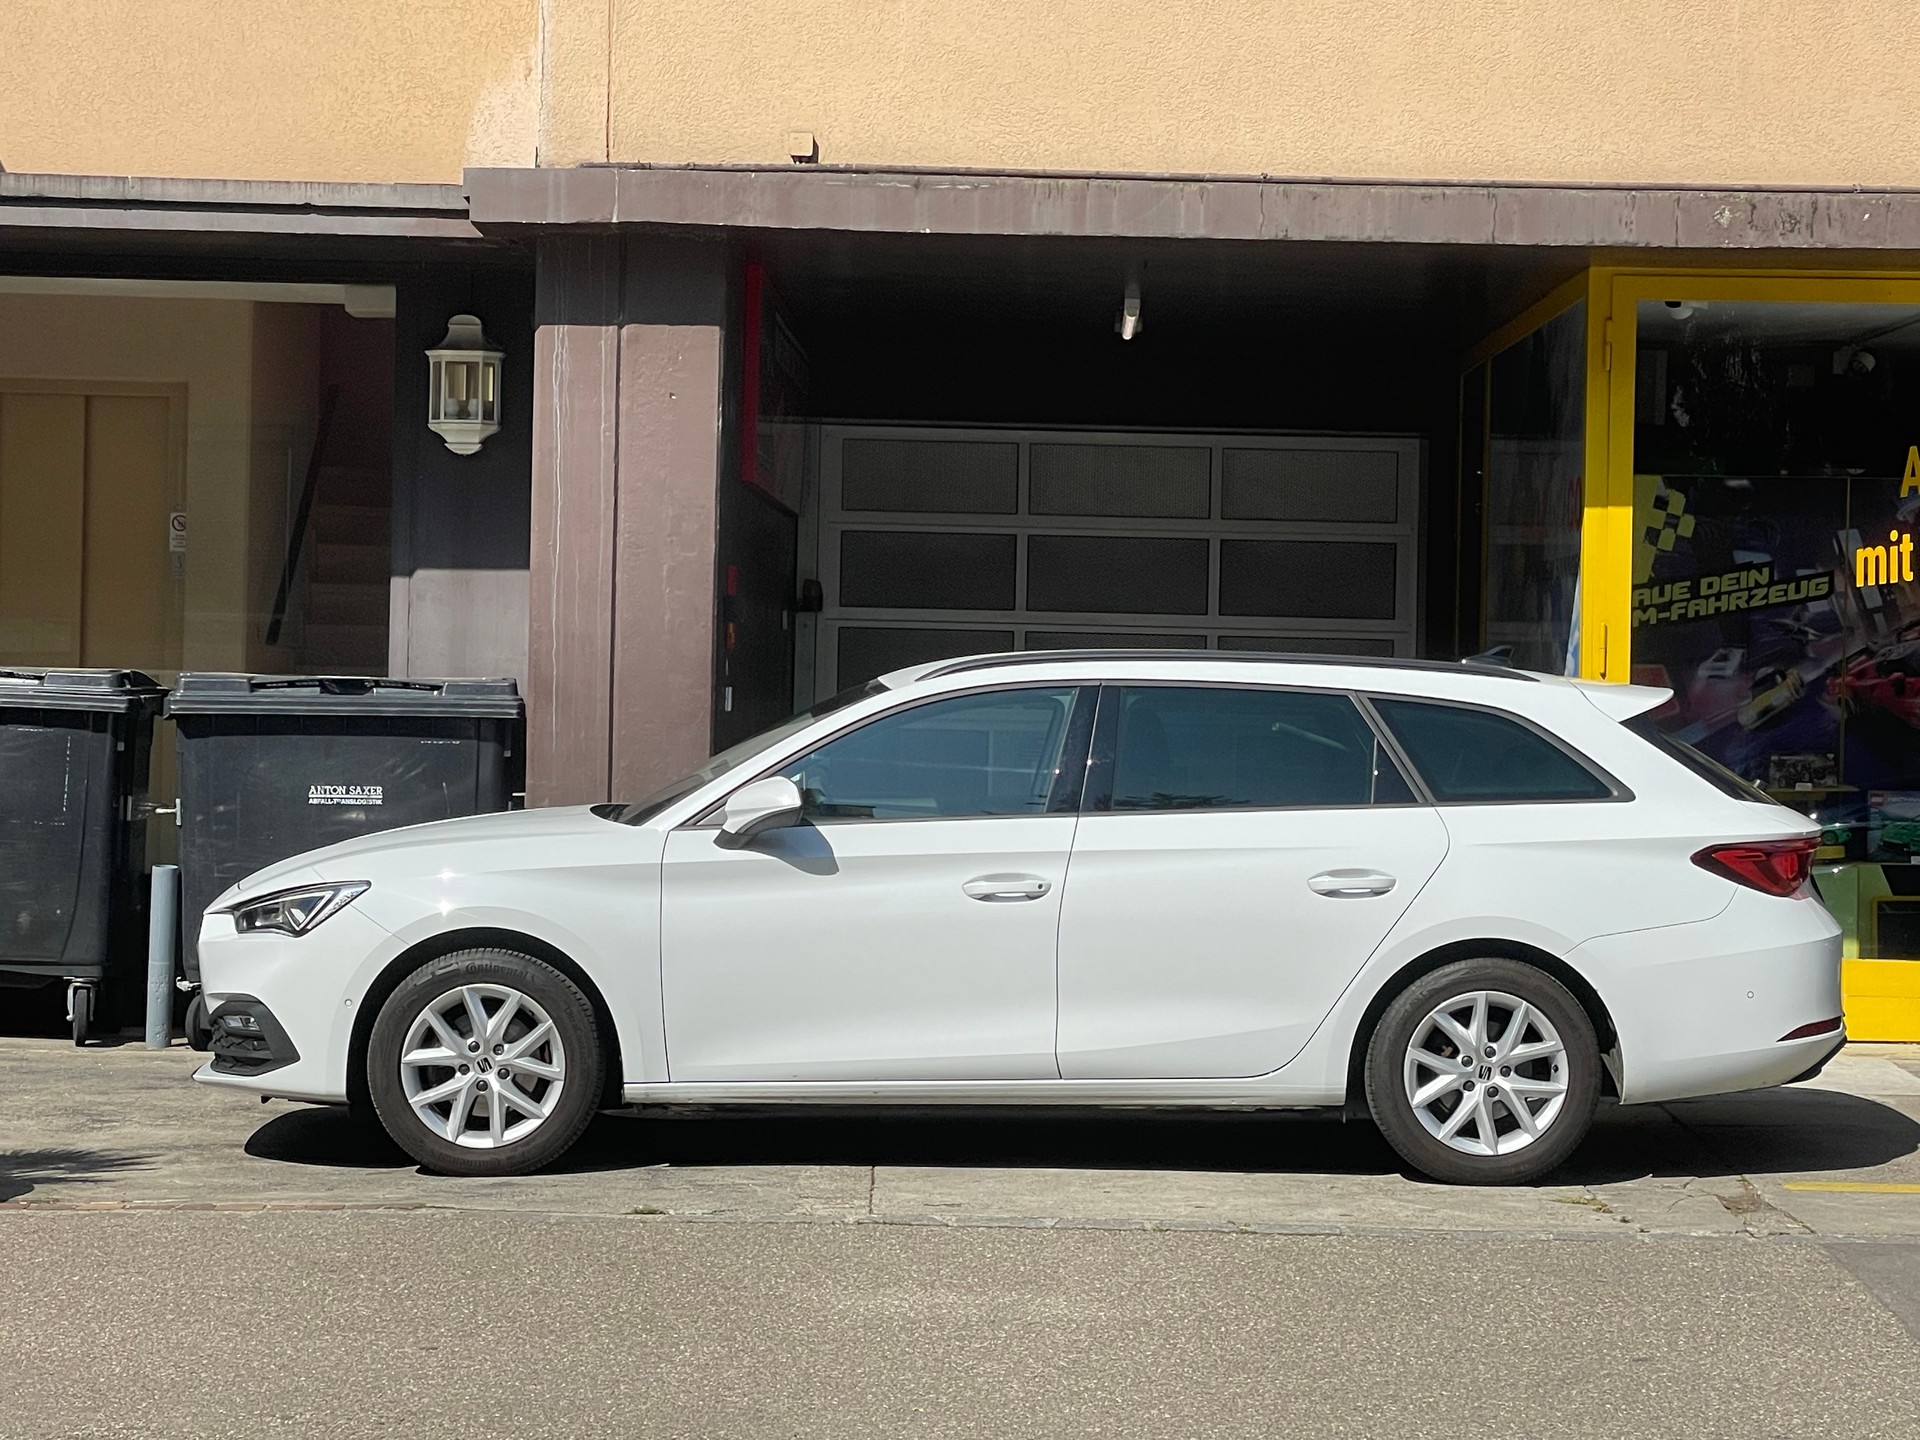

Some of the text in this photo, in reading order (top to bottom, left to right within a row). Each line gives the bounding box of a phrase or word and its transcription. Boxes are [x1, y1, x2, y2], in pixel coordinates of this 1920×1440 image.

[1856, 529, 1914, 588] mit
[1700, 566, 1770, 596] DEIN
[308, 785, 383, 795] ANTON SAXER
[465, 962, 529, 981] Continental
